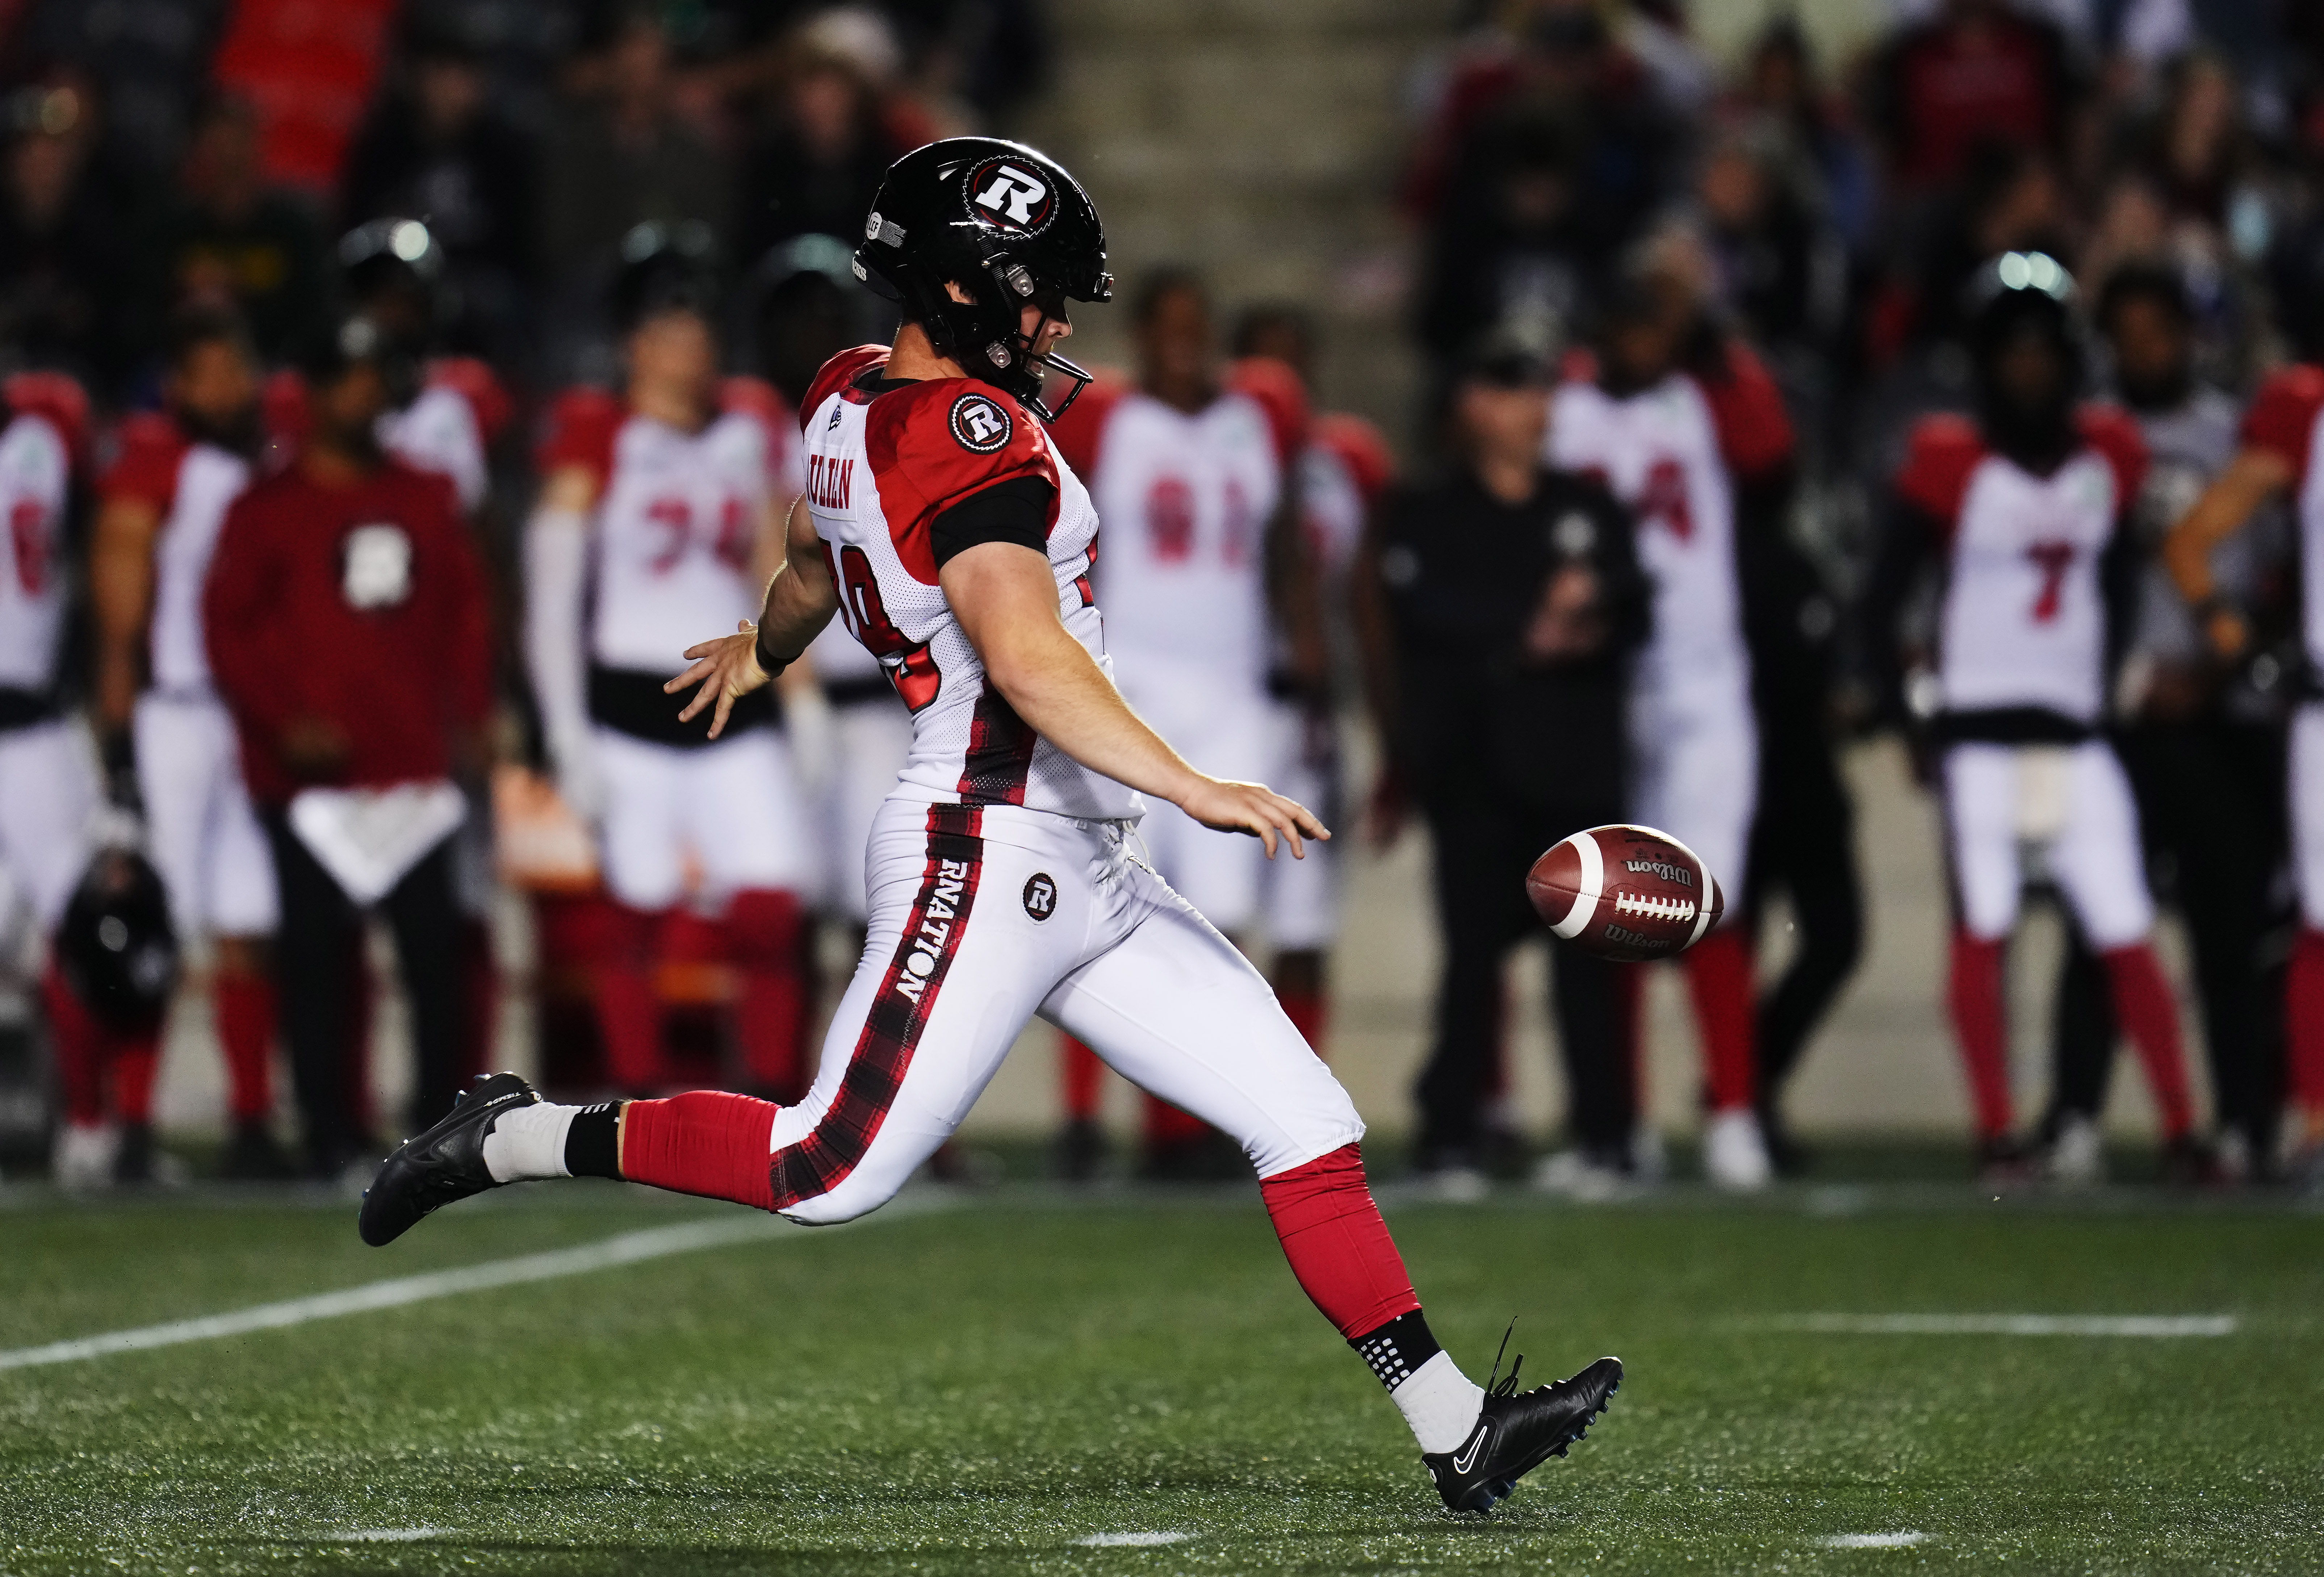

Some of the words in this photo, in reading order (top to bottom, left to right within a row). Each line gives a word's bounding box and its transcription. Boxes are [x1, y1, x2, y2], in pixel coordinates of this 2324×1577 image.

[975, 165, 1046, 225] R
[868, 219, 879, 232] LCF
[963, 404, 1002, 442] R
[1626, 860, 1692, 887] Wilson
[1028, 881, 1052, 912] R
[1604, 923, 1670, 948] Wilson
